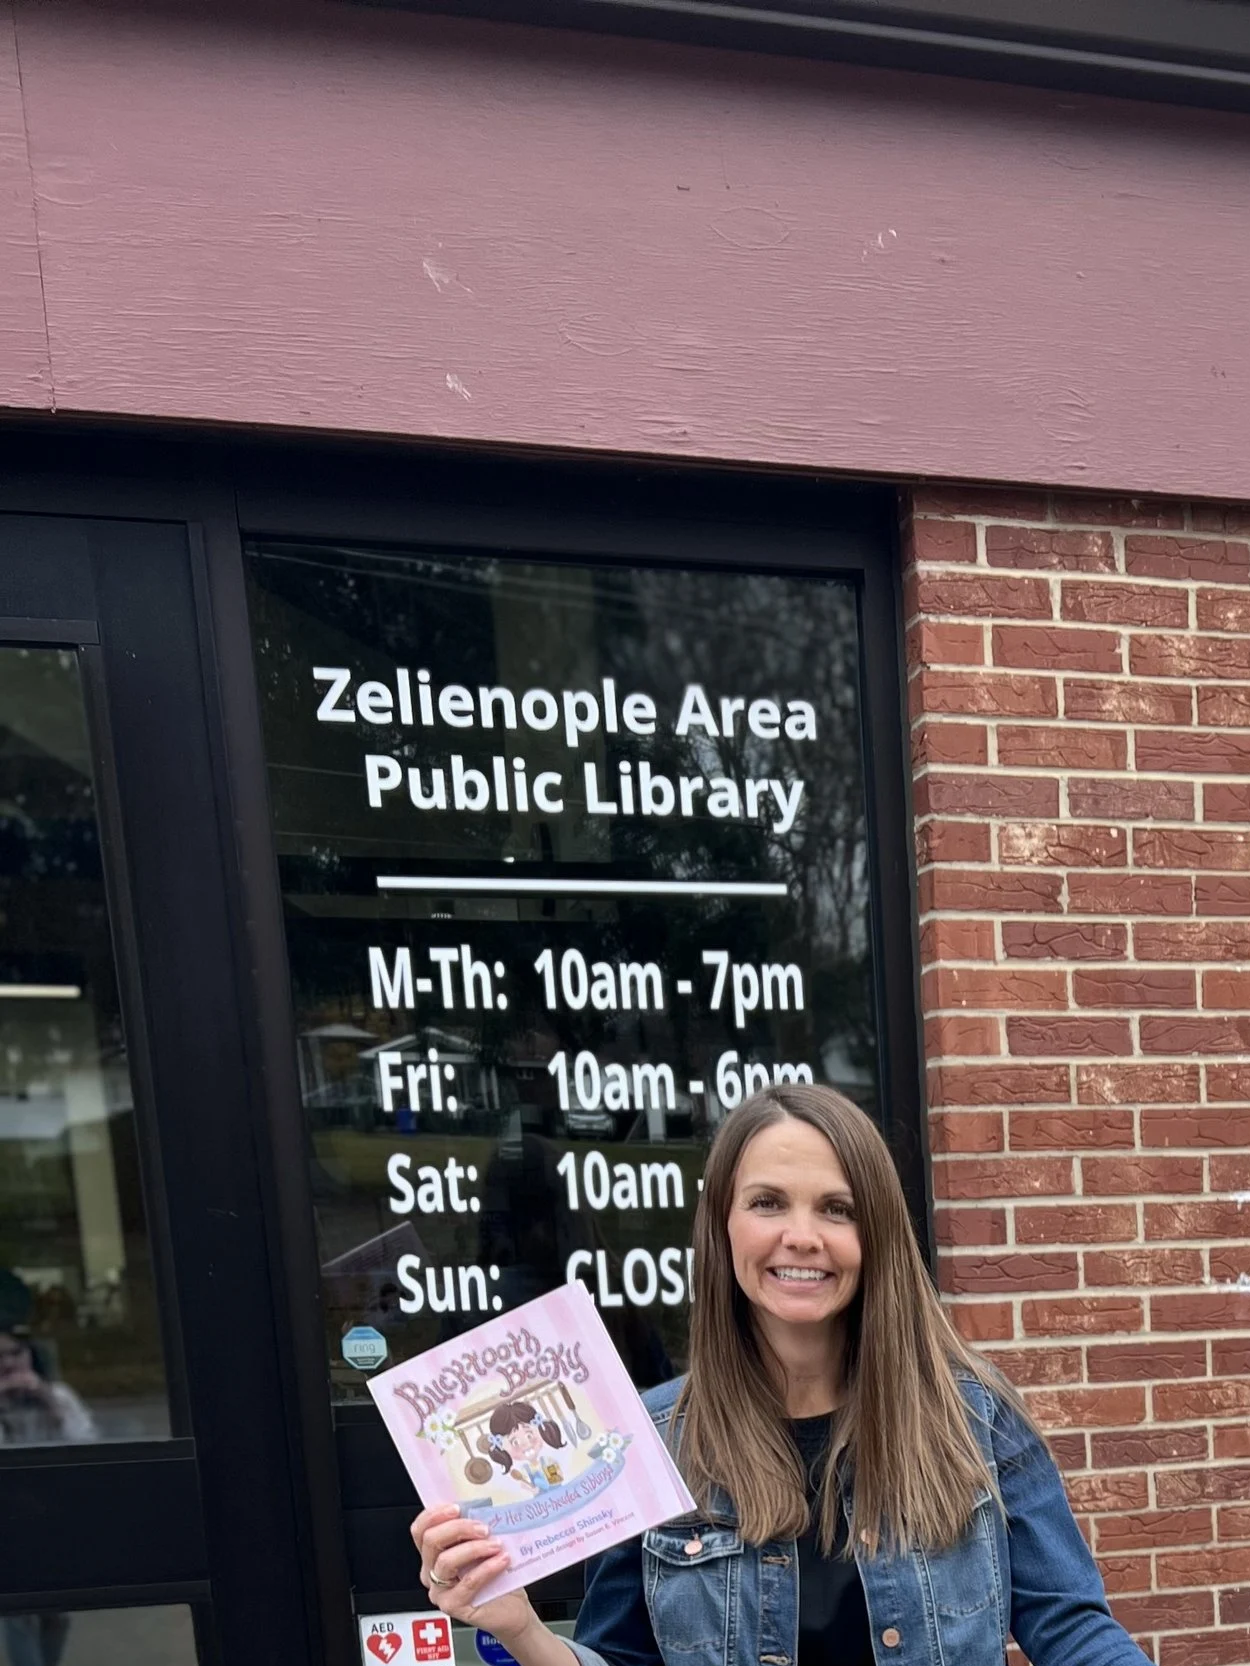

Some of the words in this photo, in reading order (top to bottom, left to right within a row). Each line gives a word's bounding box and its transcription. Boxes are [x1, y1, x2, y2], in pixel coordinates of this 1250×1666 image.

[313, 668, 656, 747] Zelienople
[676, 685, 816, 740] Area
[366, 755, 563, 813] Public
[584, 762, 804, 833] Library
[369, 945, 508, 1009] M-Th:
[535, 949, 663, 1009] 10am
[703, 951, 803, 1028] 7pm
[379, 1048, 457, 1112] Fri:
[548, 1051, 676, 1110] 10am
[388, 1154, 480, 1213] Sat:
[557, 1151, 684, 1209] 10am
[397, 1255, 502, 1313] Sun:
[354, 1343, 376, 1353] ring
[496, 1341, 589, 1397] Becky
[504, 1510, 523, 1525] Her
[520, 1544, 533, 1557] By
[535, 1526, 576, 1549] Rebecca
[577, 1509, 614, 1530] Shinsky
[371, 1622, 394, 1633] AED
[416, 1646, 436, 1655] FIRST
